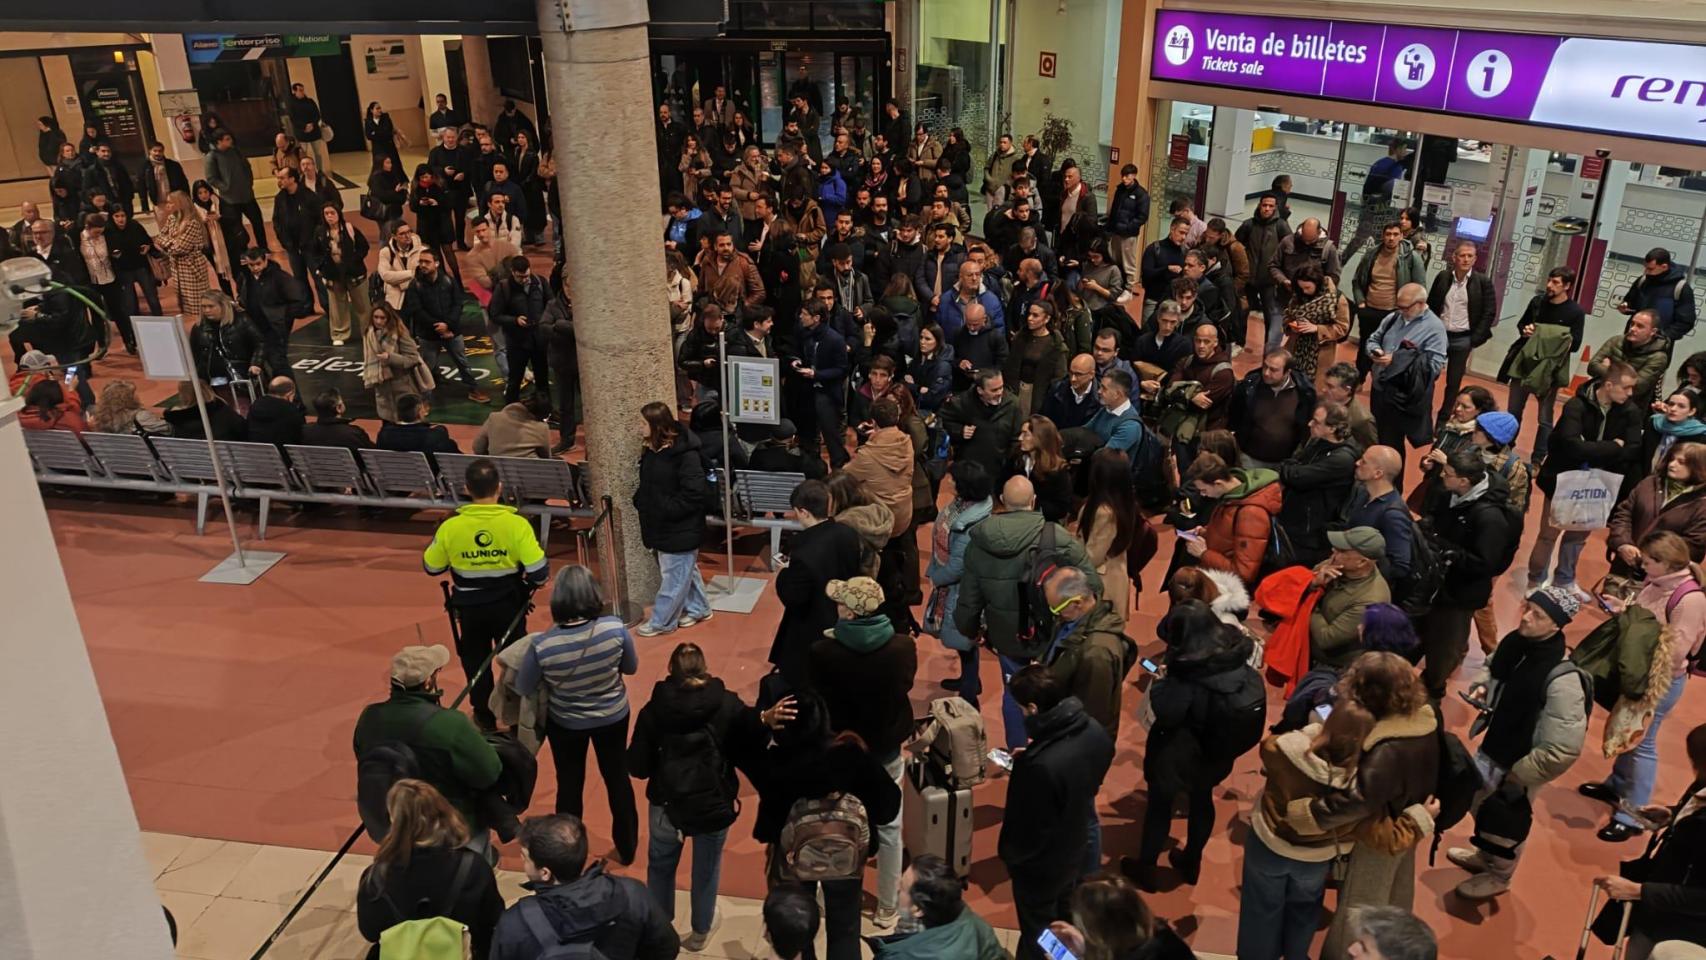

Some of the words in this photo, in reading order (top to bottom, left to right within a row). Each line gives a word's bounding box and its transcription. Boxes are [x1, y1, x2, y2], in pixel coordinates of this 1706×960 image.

[225, 37, 281, 48] enterprise
[298, 35, 330, 43] National
[1206, 28, 1256, 54] Venta
[1262, 32, 1286, 57] de
[1290, 34, 1368, 64] billetes
[1202, 56, 1238, 73] Tickets
[1240, 60, 1265, 76] sale
[1610, 75, 1706, 122] ren
[1570, 488, 1607, 500] ACTION
[461, 549, 508, 559] ILUNION
